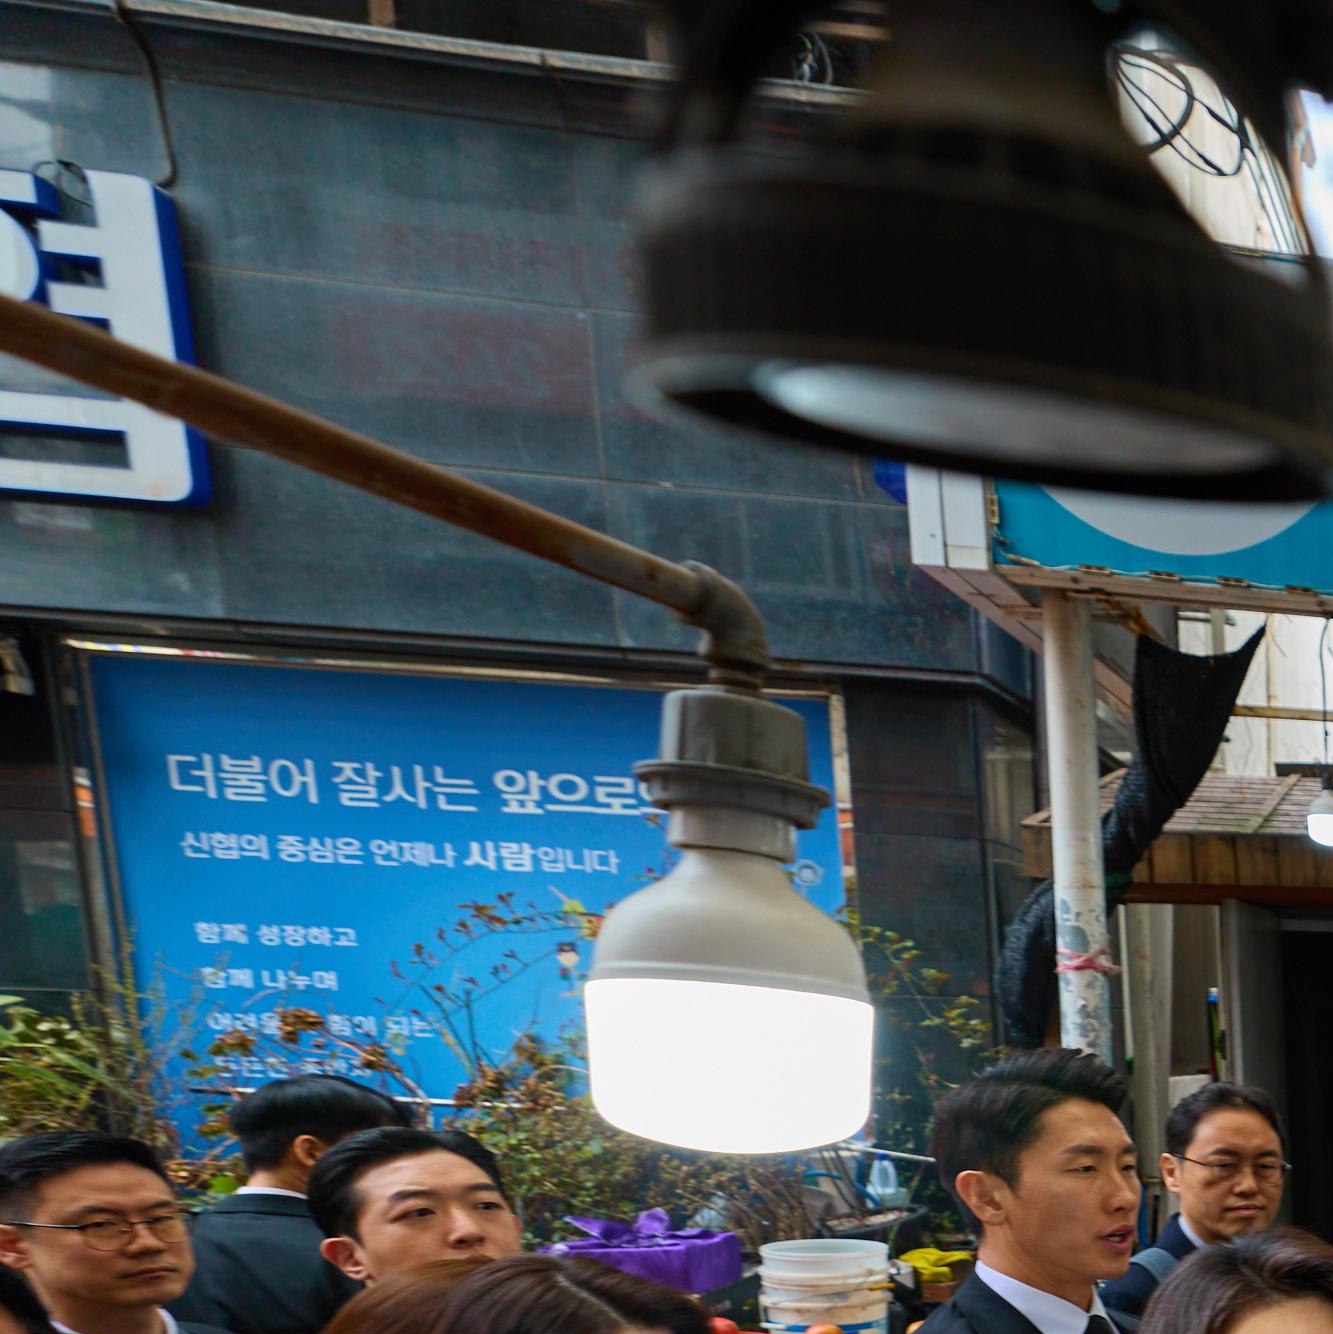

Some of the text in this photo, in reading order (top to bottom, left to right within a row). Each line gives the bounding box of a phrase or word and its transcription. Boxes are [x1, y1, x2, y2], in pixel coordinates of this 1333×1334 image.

[166, 753, 669, 817] 더불어 잘사는 앞으로
[179, 830, 621, 875] 신협의 중심은 언제나 사람입니다
[194, 921, 360, 949] 함께 성장하고
